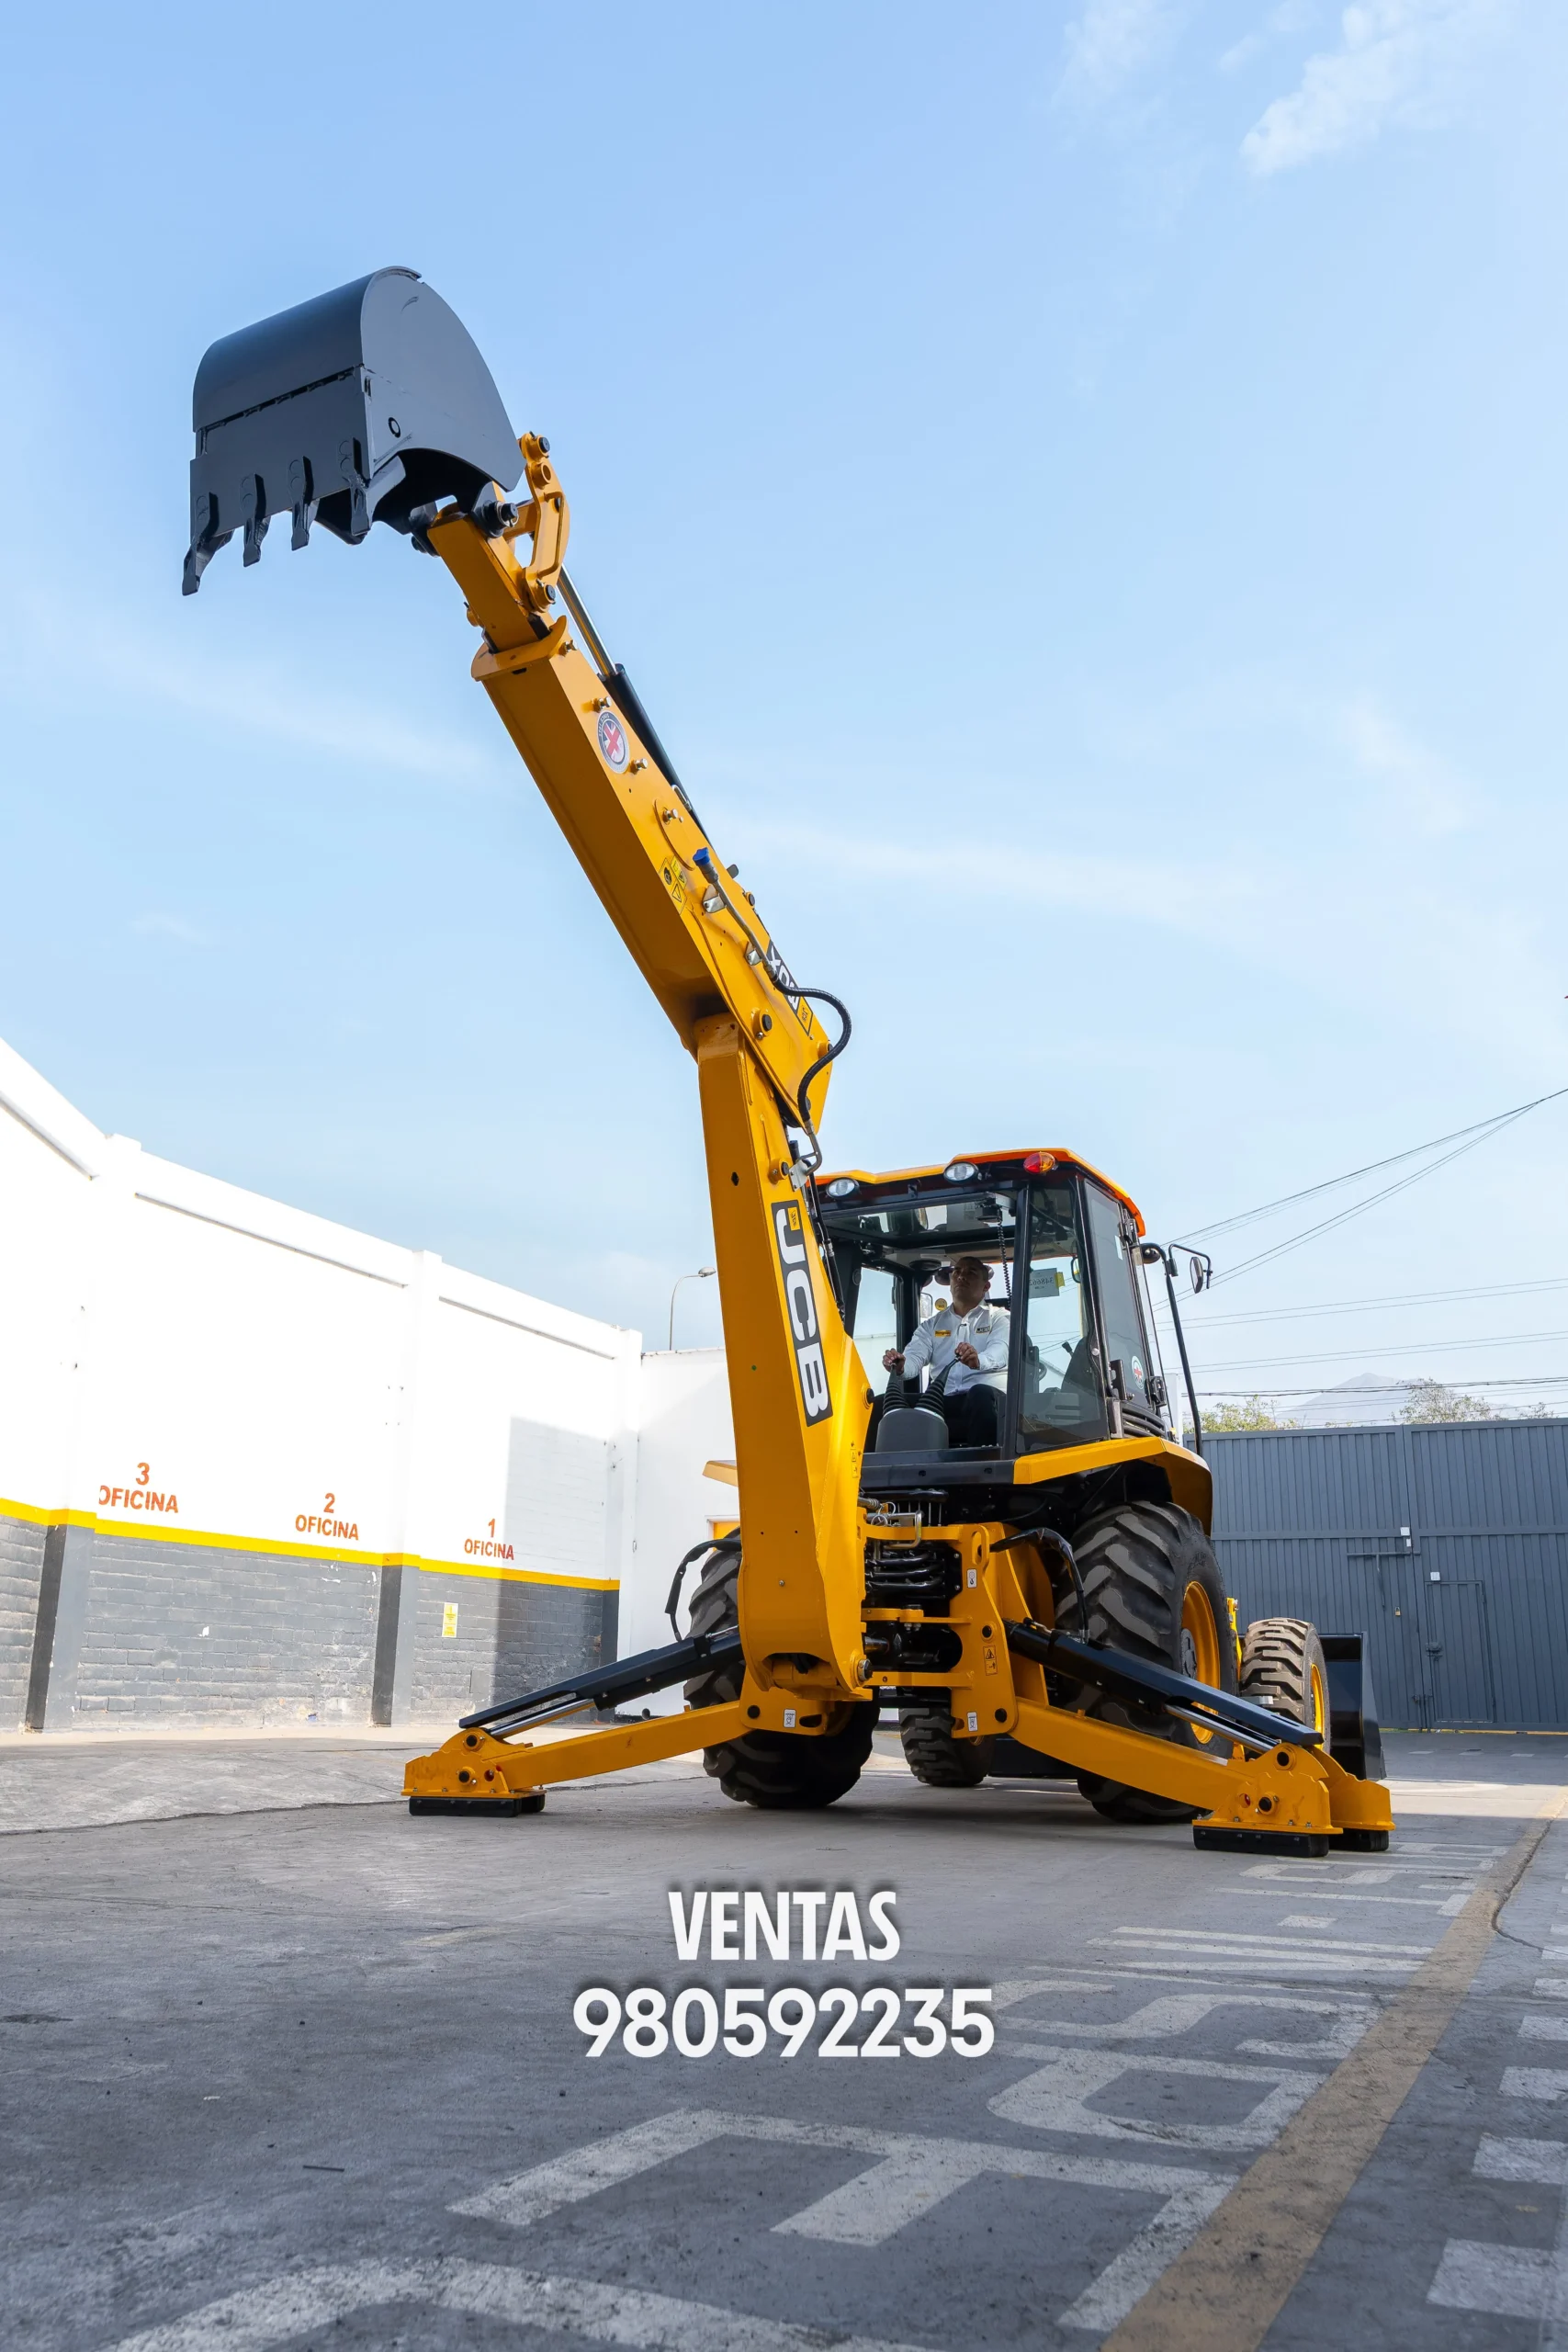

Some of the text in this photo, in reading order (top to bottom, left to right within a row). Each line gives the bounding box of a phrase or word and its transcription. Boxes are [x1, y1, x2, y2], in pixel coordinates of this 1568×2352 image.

[775, 1208, 829, 1418] JCB
[136, 1462, 150, 1485] 3
[99, 1486, 178, 1513] OFICINA
[324, 1493, 335, 1514] 2
[295, 1514, 359, 1541] OFICINA
[488, 1519, 496, 1538] 1
[464, 1539, 514, 1561] OFICINA
